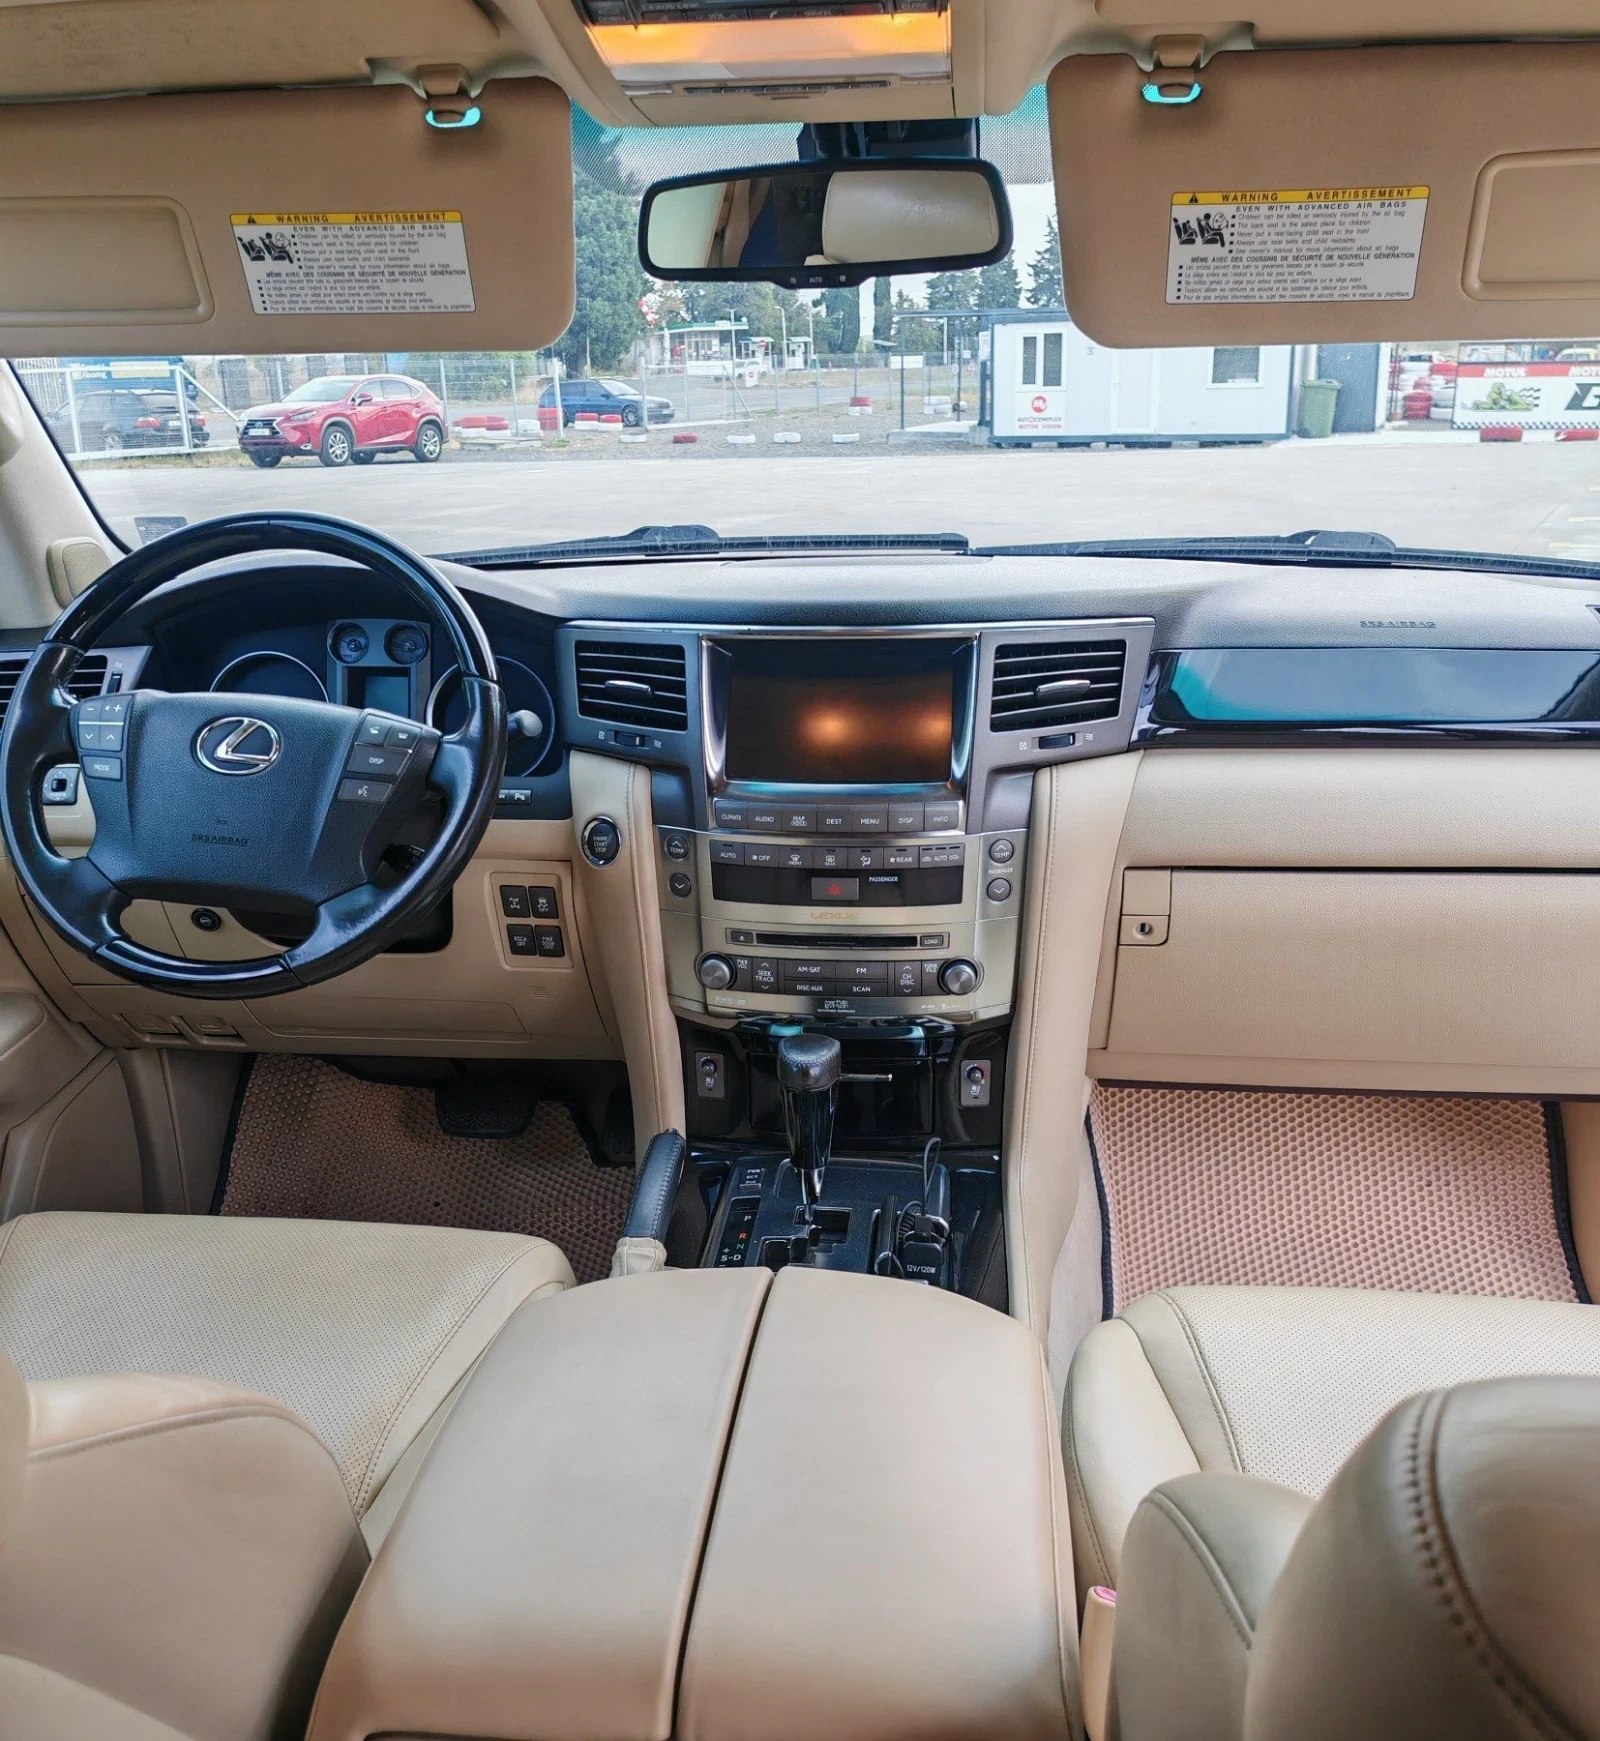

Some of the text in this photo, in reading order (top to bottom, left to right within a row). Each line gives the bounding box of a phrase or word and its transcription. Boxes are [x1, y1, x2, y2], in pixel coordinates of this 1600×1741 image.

[1221, 188, 1412, 202] WARNING AVERTISSEMENT
[354, 214, 446, 222] AVERTISSEMENT
[1484, 367, 1526, 377] MOTUL
[369, 756, 384, 764] DISP
[94, 764, 110, 772] MODE
[907, 1264, 936, 1274] 12V/120W
